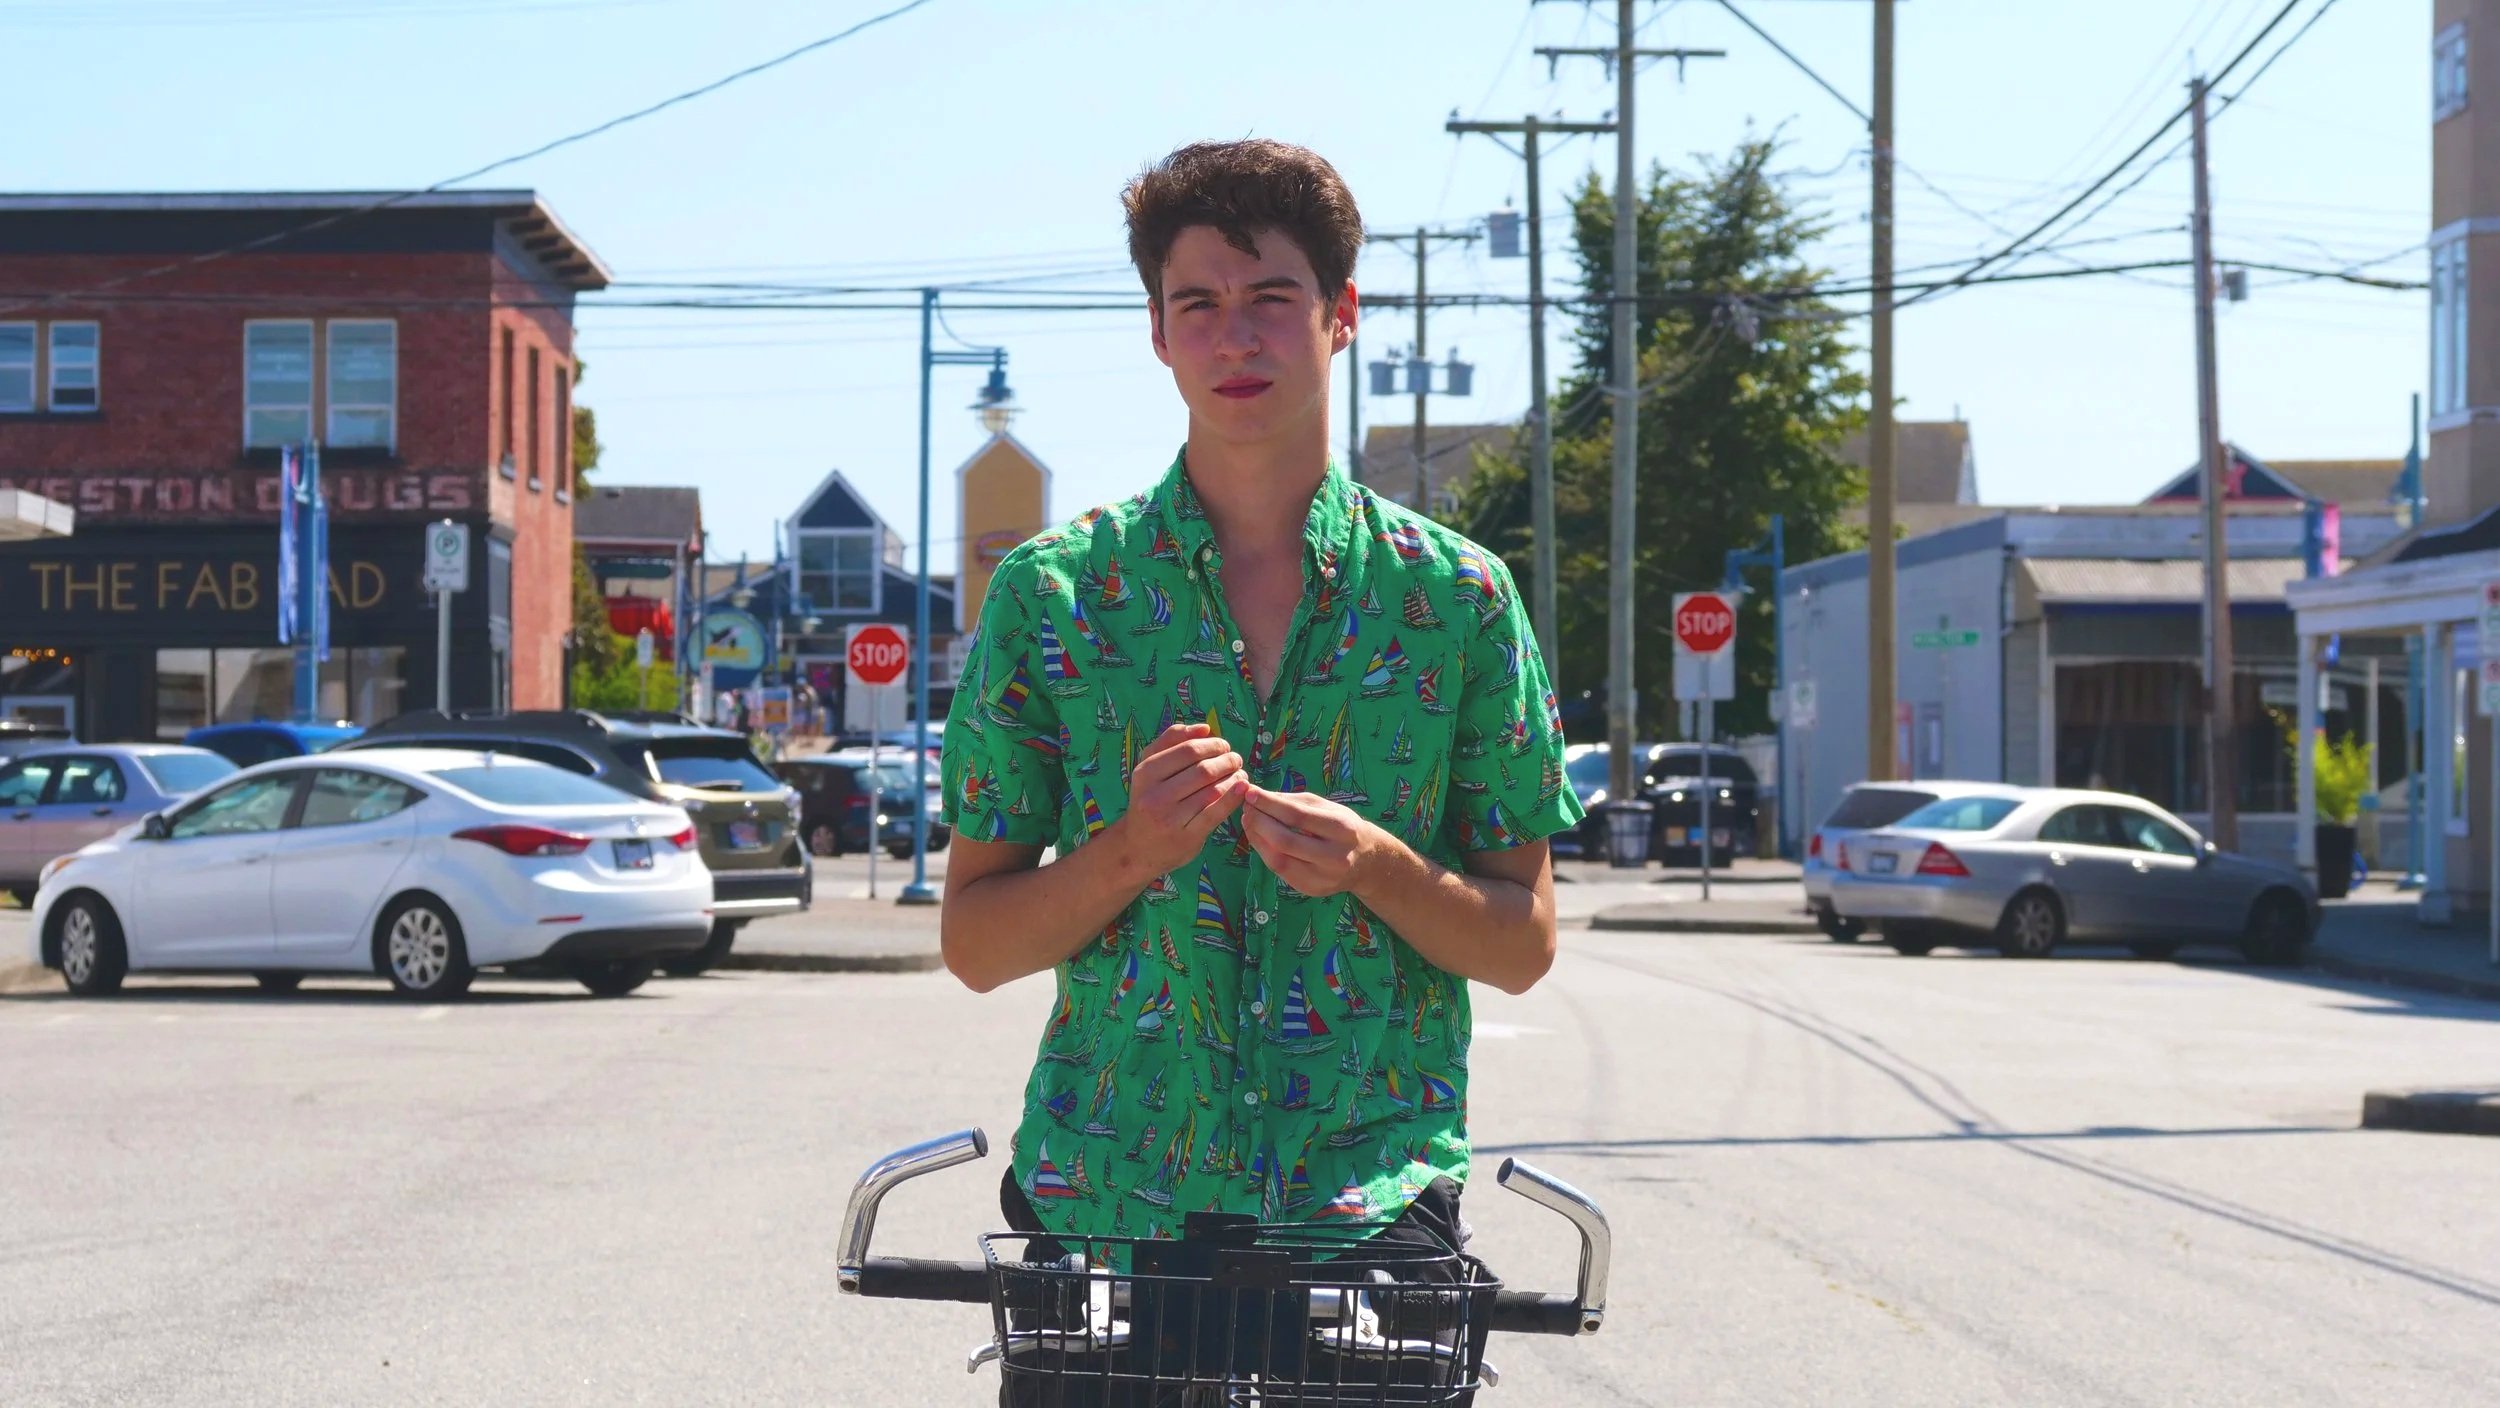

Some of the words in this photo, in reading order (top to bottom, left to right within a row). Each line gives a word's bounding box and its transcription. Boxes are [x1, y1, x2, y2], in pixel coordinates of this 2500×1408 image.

[256, 476, 470, 510] DUGS
[30, 562, 137, 611] THE
[158, 562, 259, 611] FAB
[1678, 611, 1730, 636] STOP
[852, 642, 904, 667] STOP
